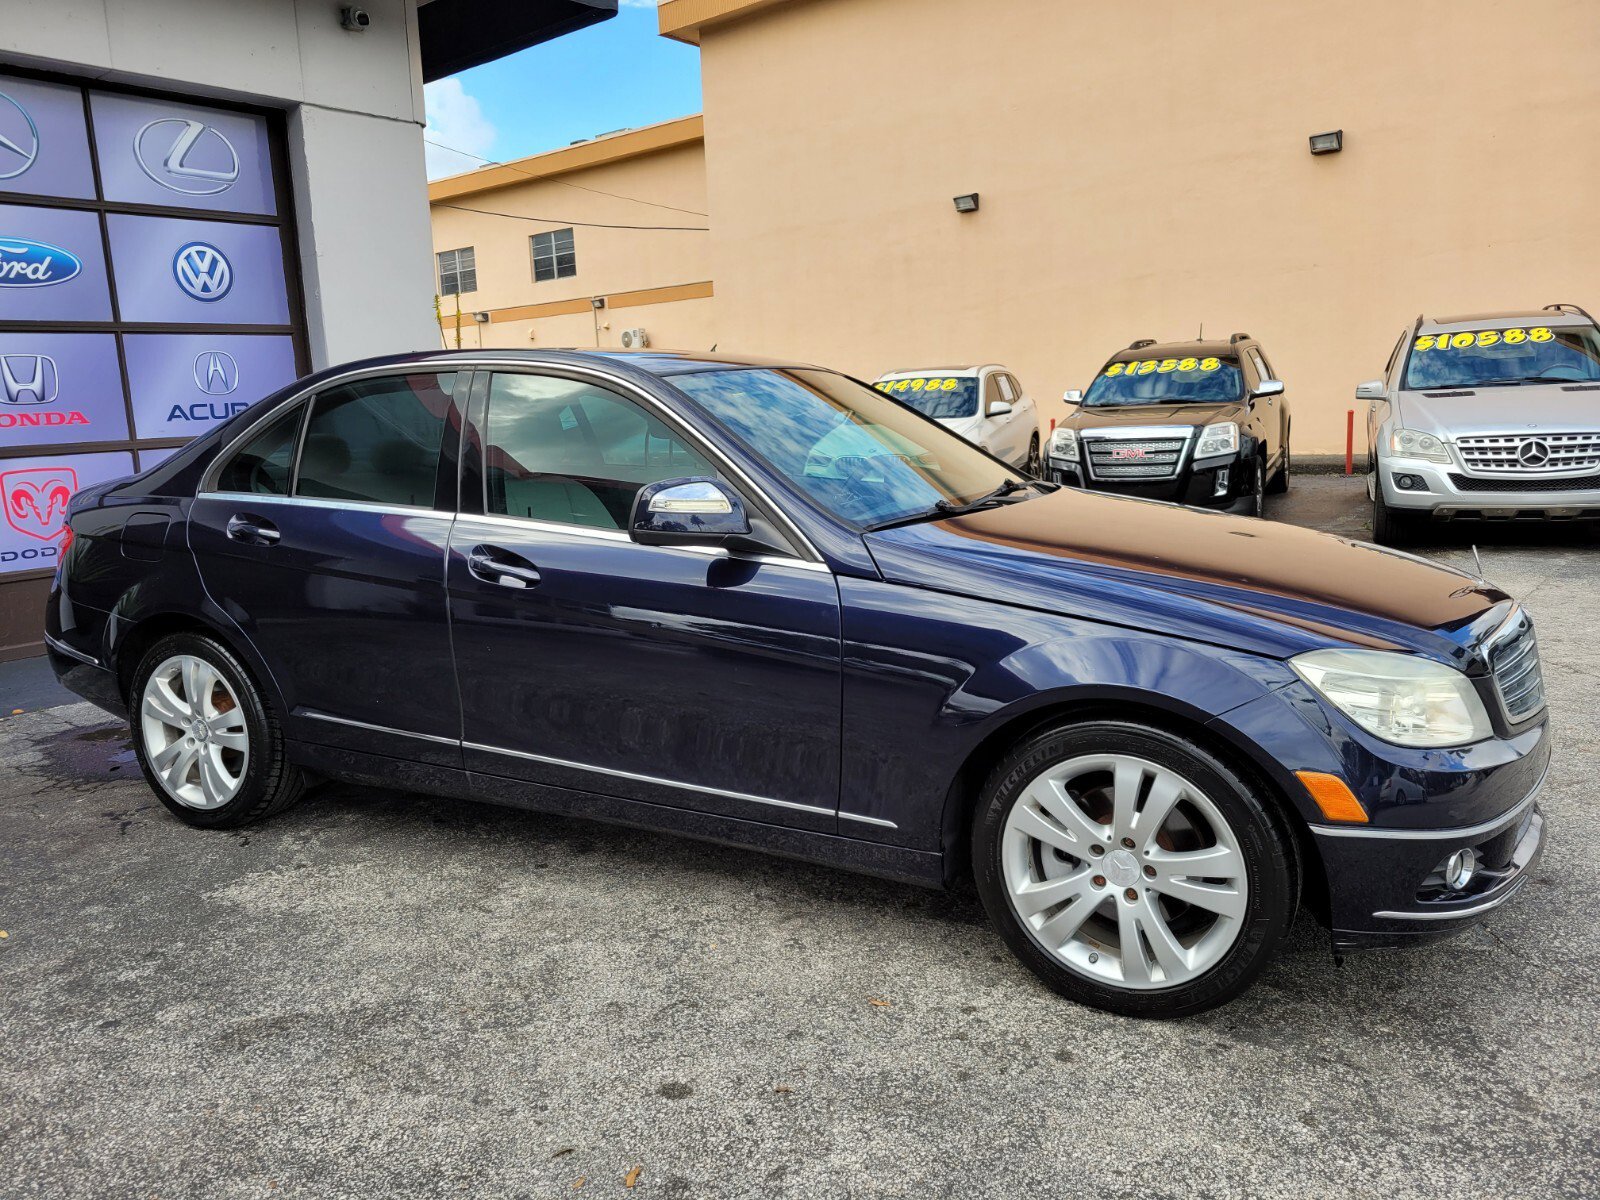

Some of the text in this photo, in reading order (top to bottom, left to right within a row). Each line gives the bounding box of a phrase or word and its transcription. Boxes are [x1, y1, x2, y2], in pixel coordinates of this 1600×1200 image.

[1414, 327, 1555, 351] $10588
[1105, 357, 1221, 377] $13588
[0, 411, 91, 428] ONDA
[166, 402, 250, 422] ACUR
[1112, 447, 1155, 459] GMC
[0, 546, 57, 562] DOD
[993, 743, 1062, 805] MICHELIN
